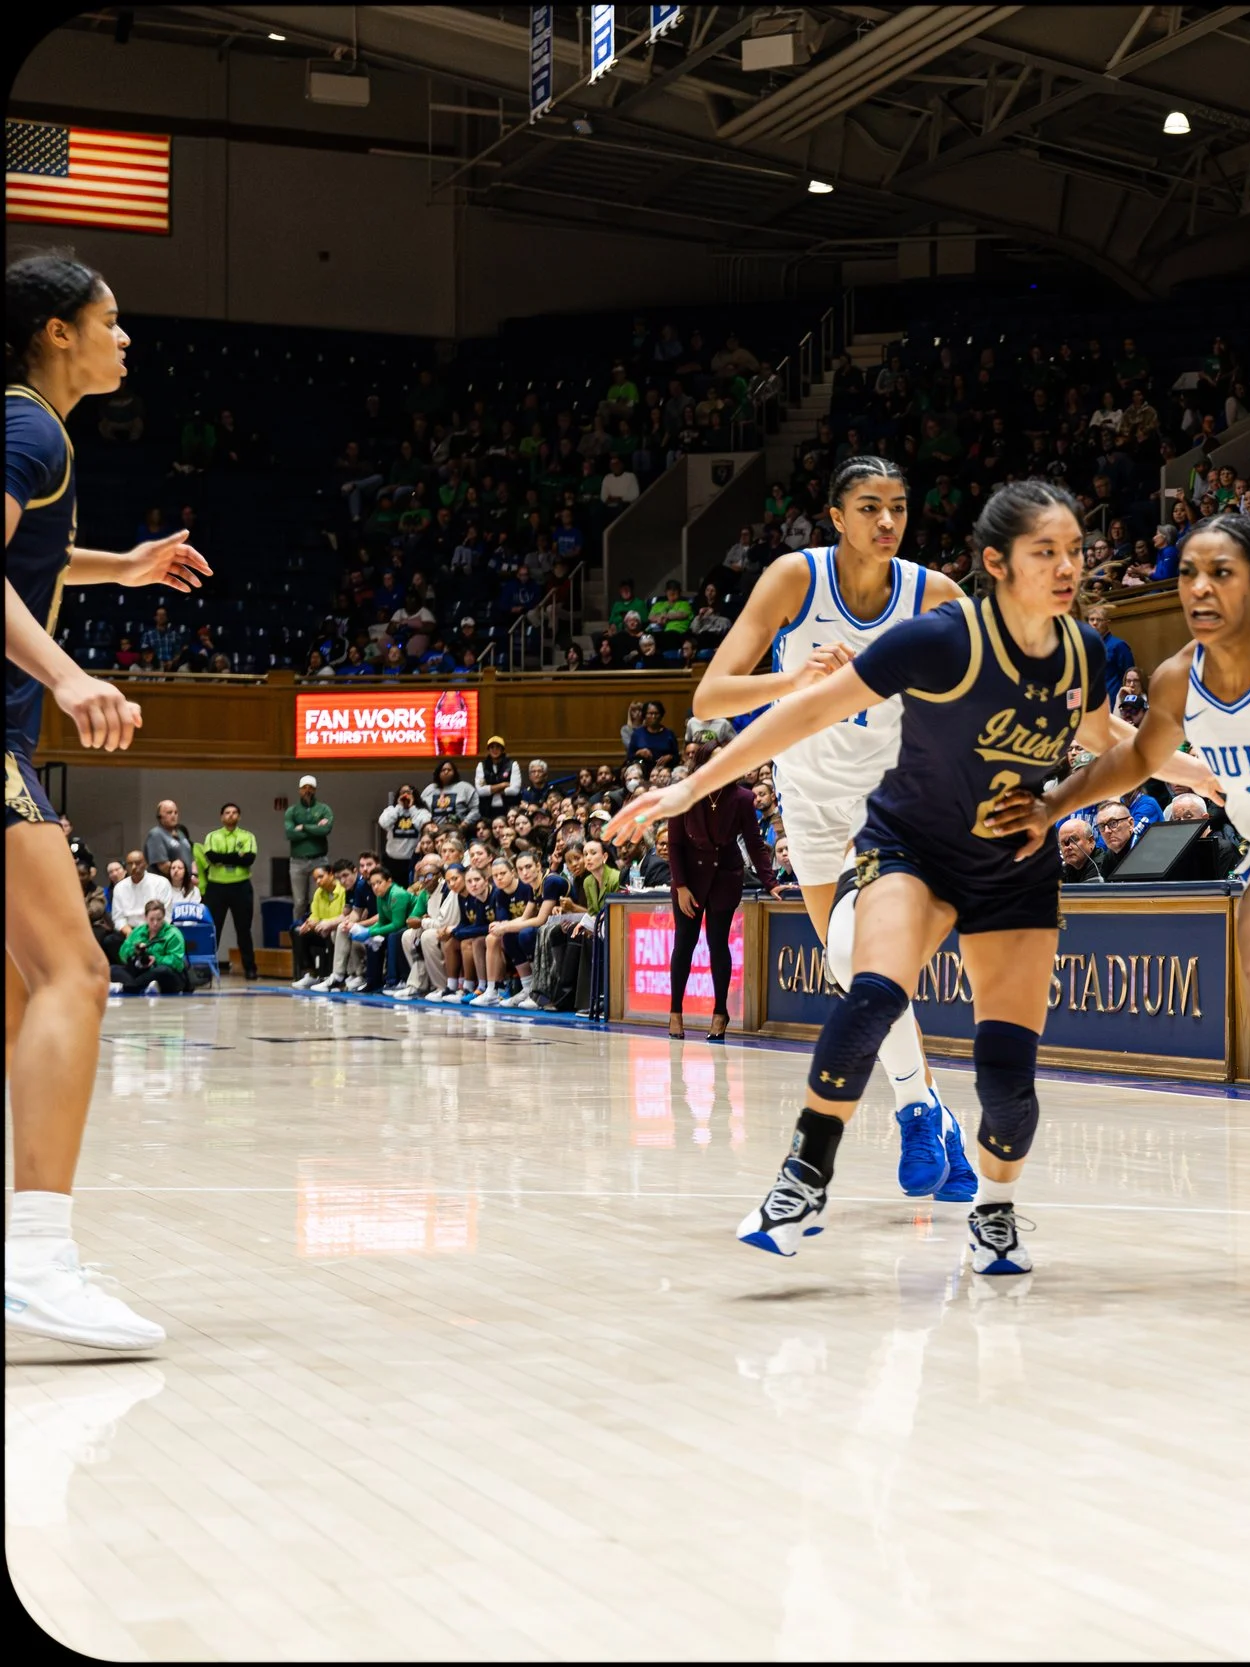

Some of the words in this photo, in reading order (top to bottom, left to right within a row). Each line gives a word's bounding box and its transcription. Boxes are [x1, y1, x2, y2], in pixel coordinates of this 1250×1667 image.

[305, 709, 349, 729] FAN
[353, 707, 426, 729] WORK
[305, 732, 318, 744] IS
[320, 730, 380, 744] THIRSTY
[381, 729, 426, 743] WORK
[976, 708, 1070, 764] Irish
[970, 770, 1021, 839] 2
[174, 904, 204, 920] DUKE
[635, 928, 666, 966] FAN
[1047, 953, 1202, 1018] STADIUM
